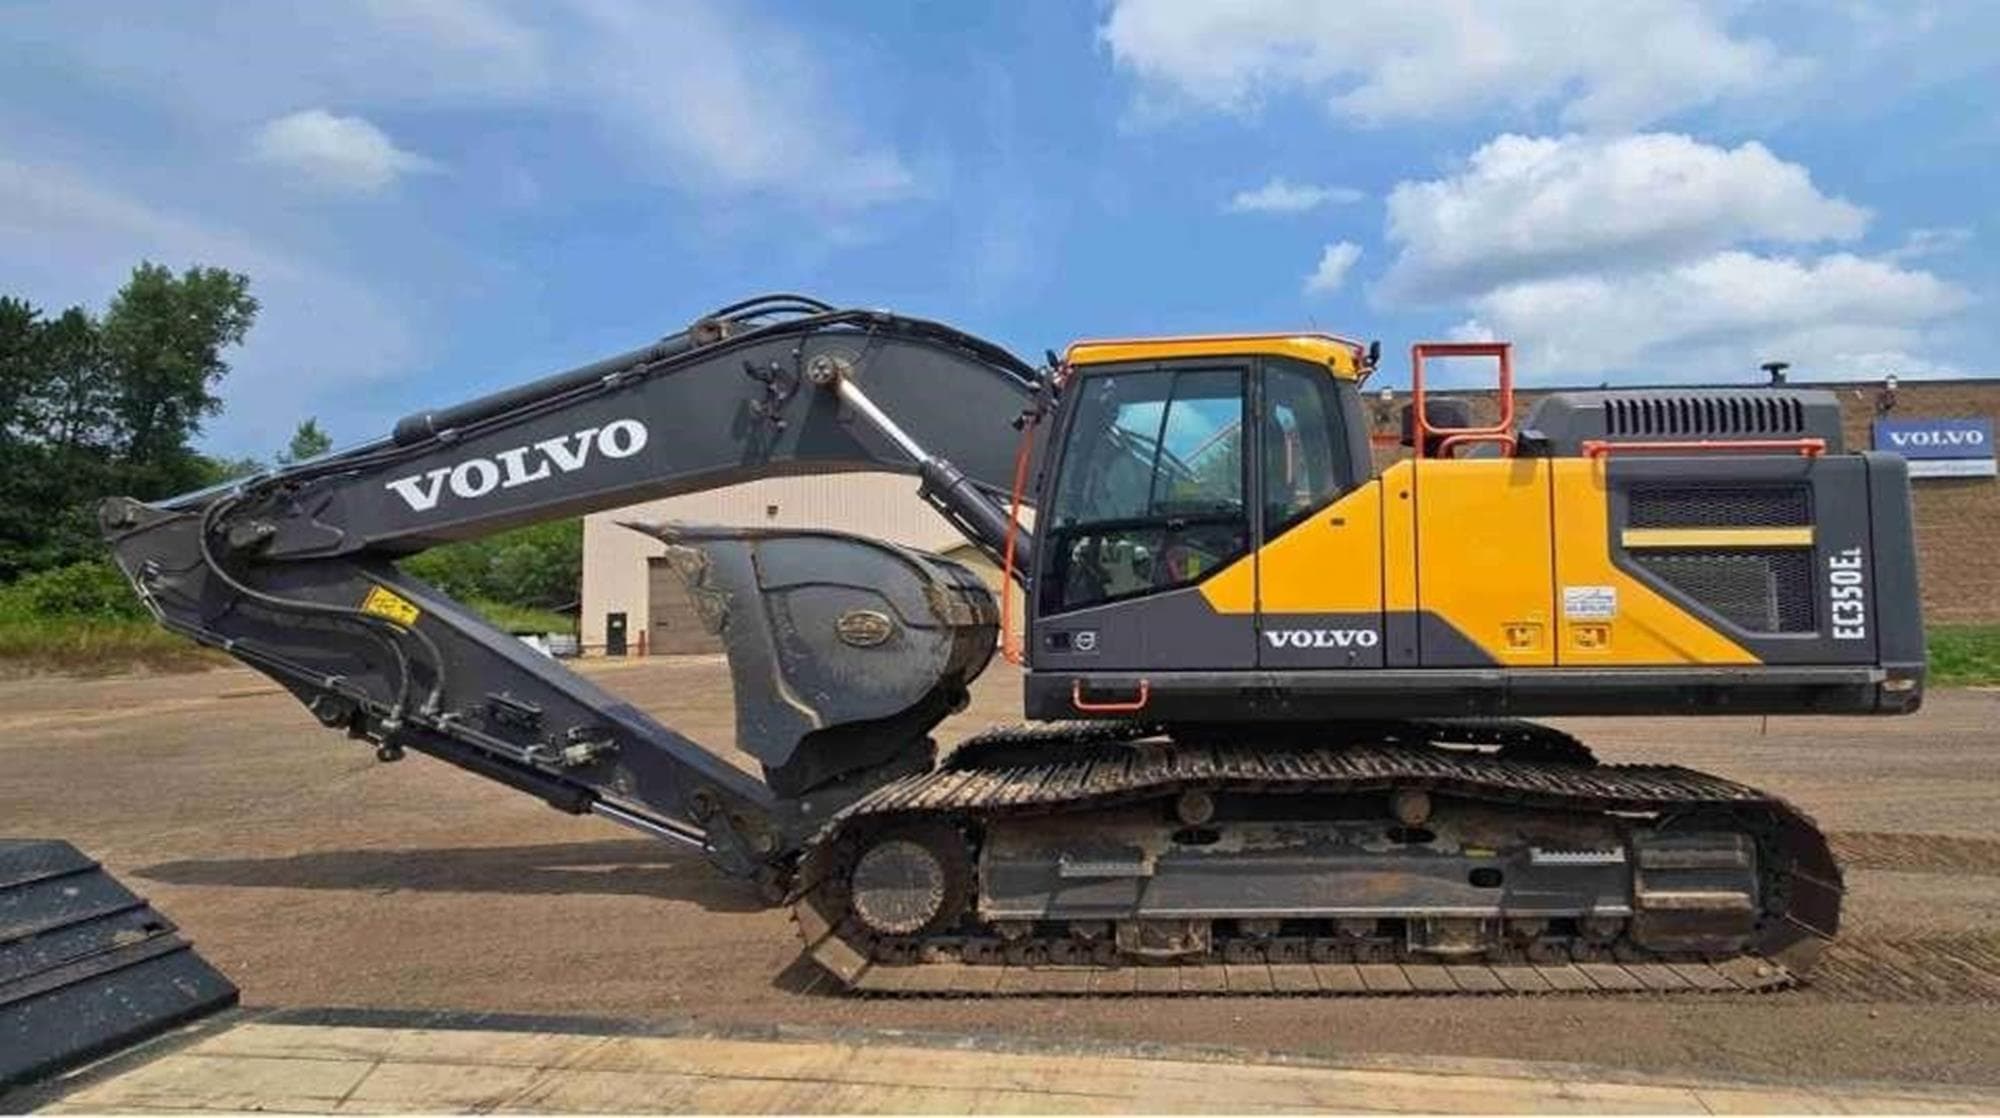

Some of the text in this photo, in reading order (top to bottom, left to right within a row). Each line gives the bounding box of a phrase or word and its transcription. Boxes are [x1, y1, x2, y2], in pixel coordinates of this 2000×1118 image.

[1889, 430, 1984, 445] VOLVO
[385, 419, 648, 512] VOLVO
[1829, 547, 1865, 639] EC350EL
[1264, 629, 1379, 648] VOLVO
